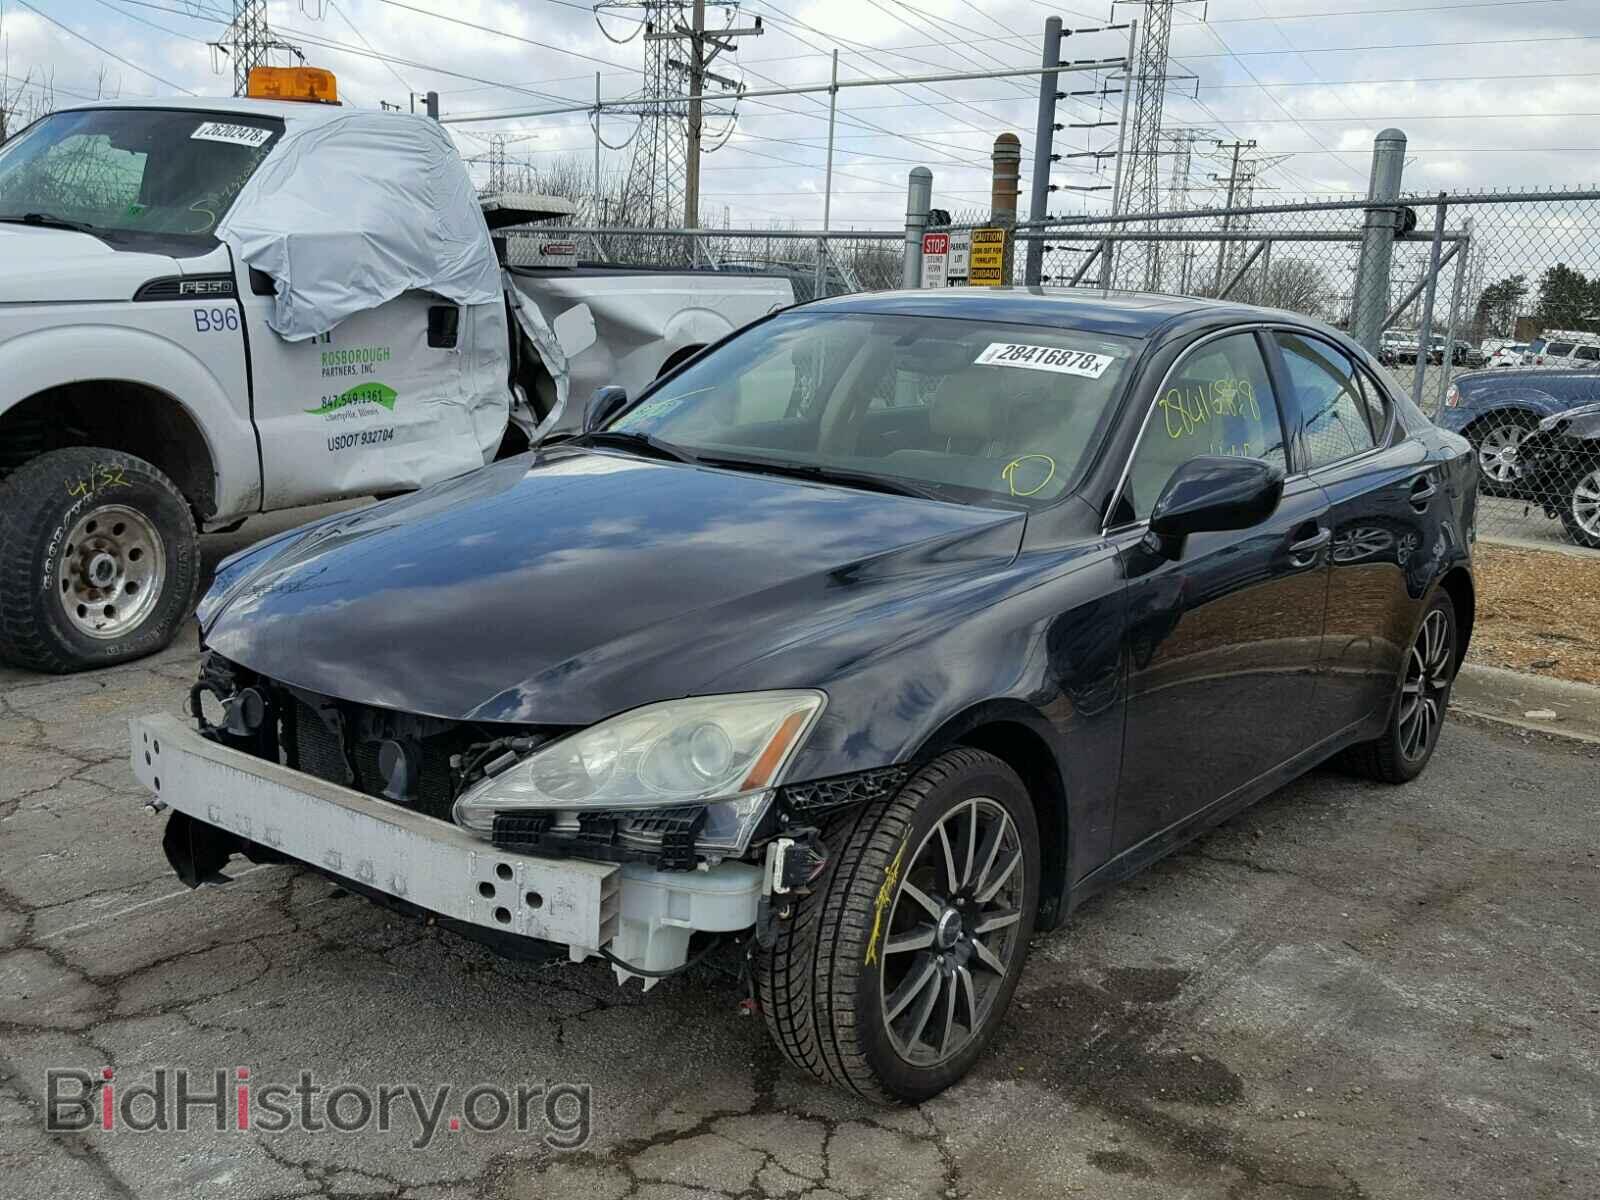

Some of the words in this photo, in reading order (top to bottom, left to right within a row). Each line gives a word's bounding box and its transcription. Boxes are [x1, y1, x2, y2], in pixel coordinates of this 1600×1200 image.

[926, 239, 946, 254] STOP
[974, 232, 1002, 242] CAUTION
[954, 254, 963, 264] LOT
[193, 307, 239, 333] B96
[321, 346, 391, 367] ROSBOROUGH
[997, 344, 1097, 370] 28416878
[321, 364, 358, 377] PARTNERS,
[361, 362, 376, 374] INC.
[321, 389, 384, 409] 847.549.1361
[327, 433, 360, 452] USDOT
[360, 427, 395, 446] 932704
